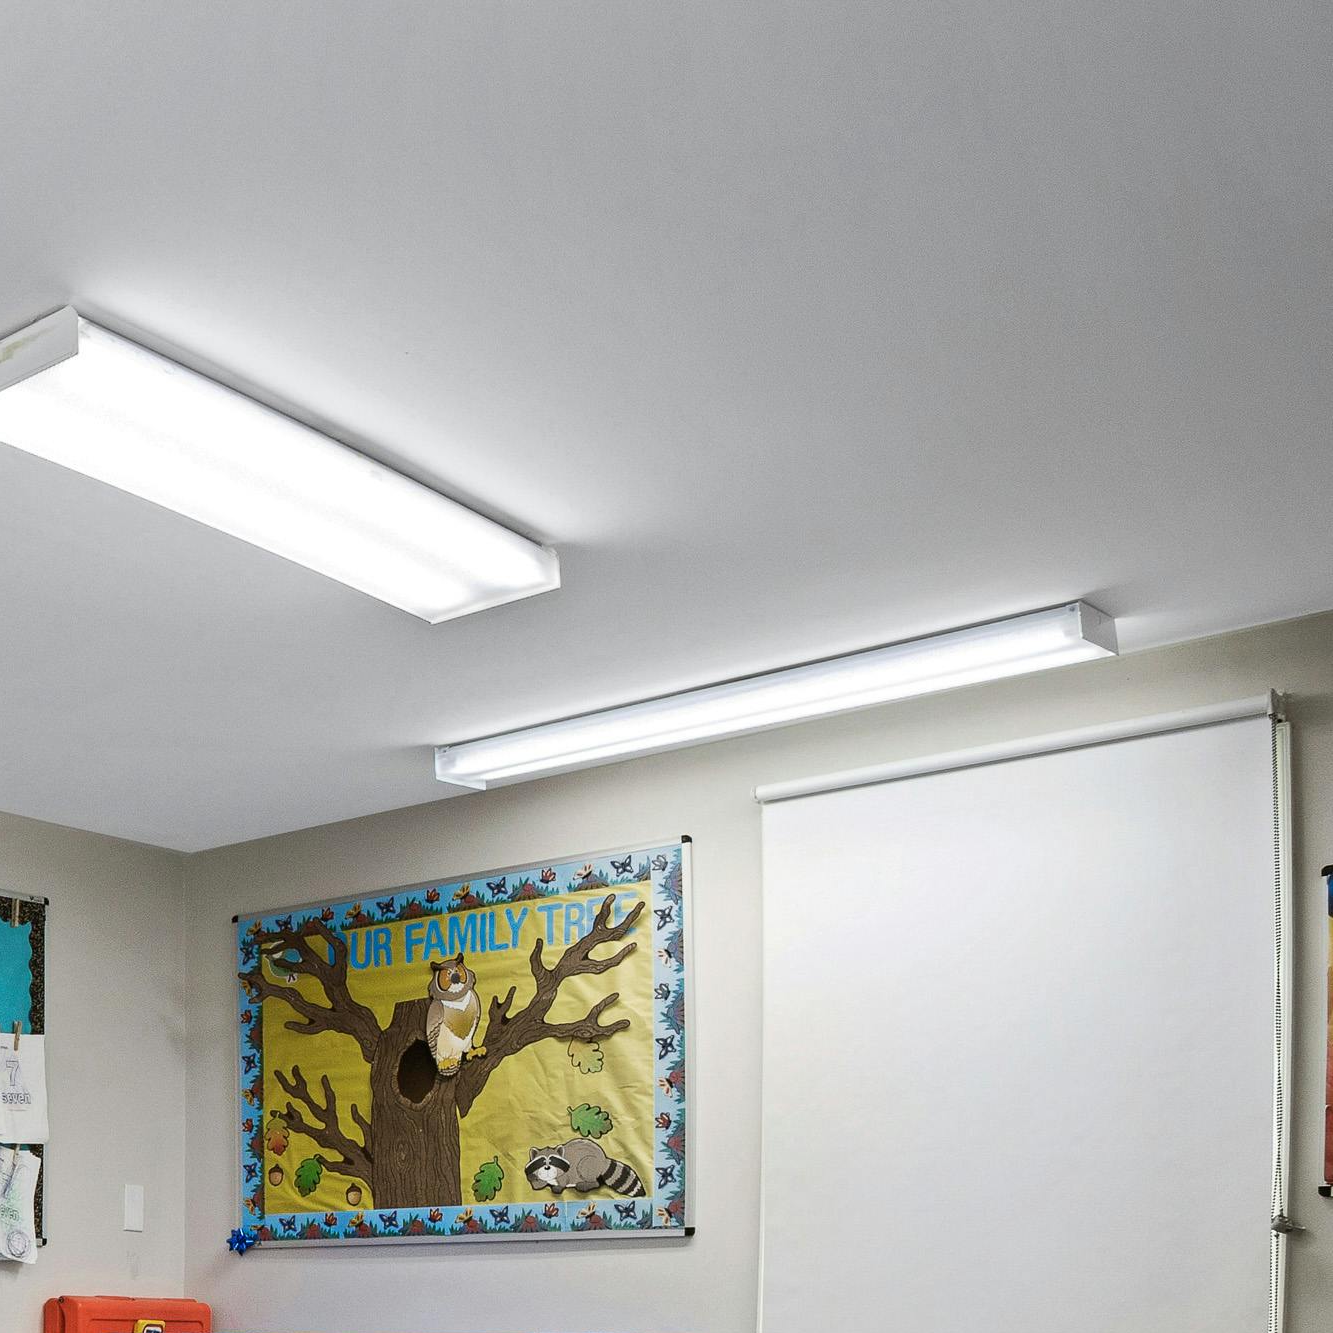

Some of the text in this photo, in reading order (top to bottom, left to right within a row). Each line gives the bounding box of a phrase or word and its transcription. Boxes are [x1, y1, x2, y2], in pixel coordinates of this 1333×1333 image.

[404, 905, 530, 964] FAMILY
[5, 1060, 19, 1087] 7
[1, 1091, 31, 1105] seven
